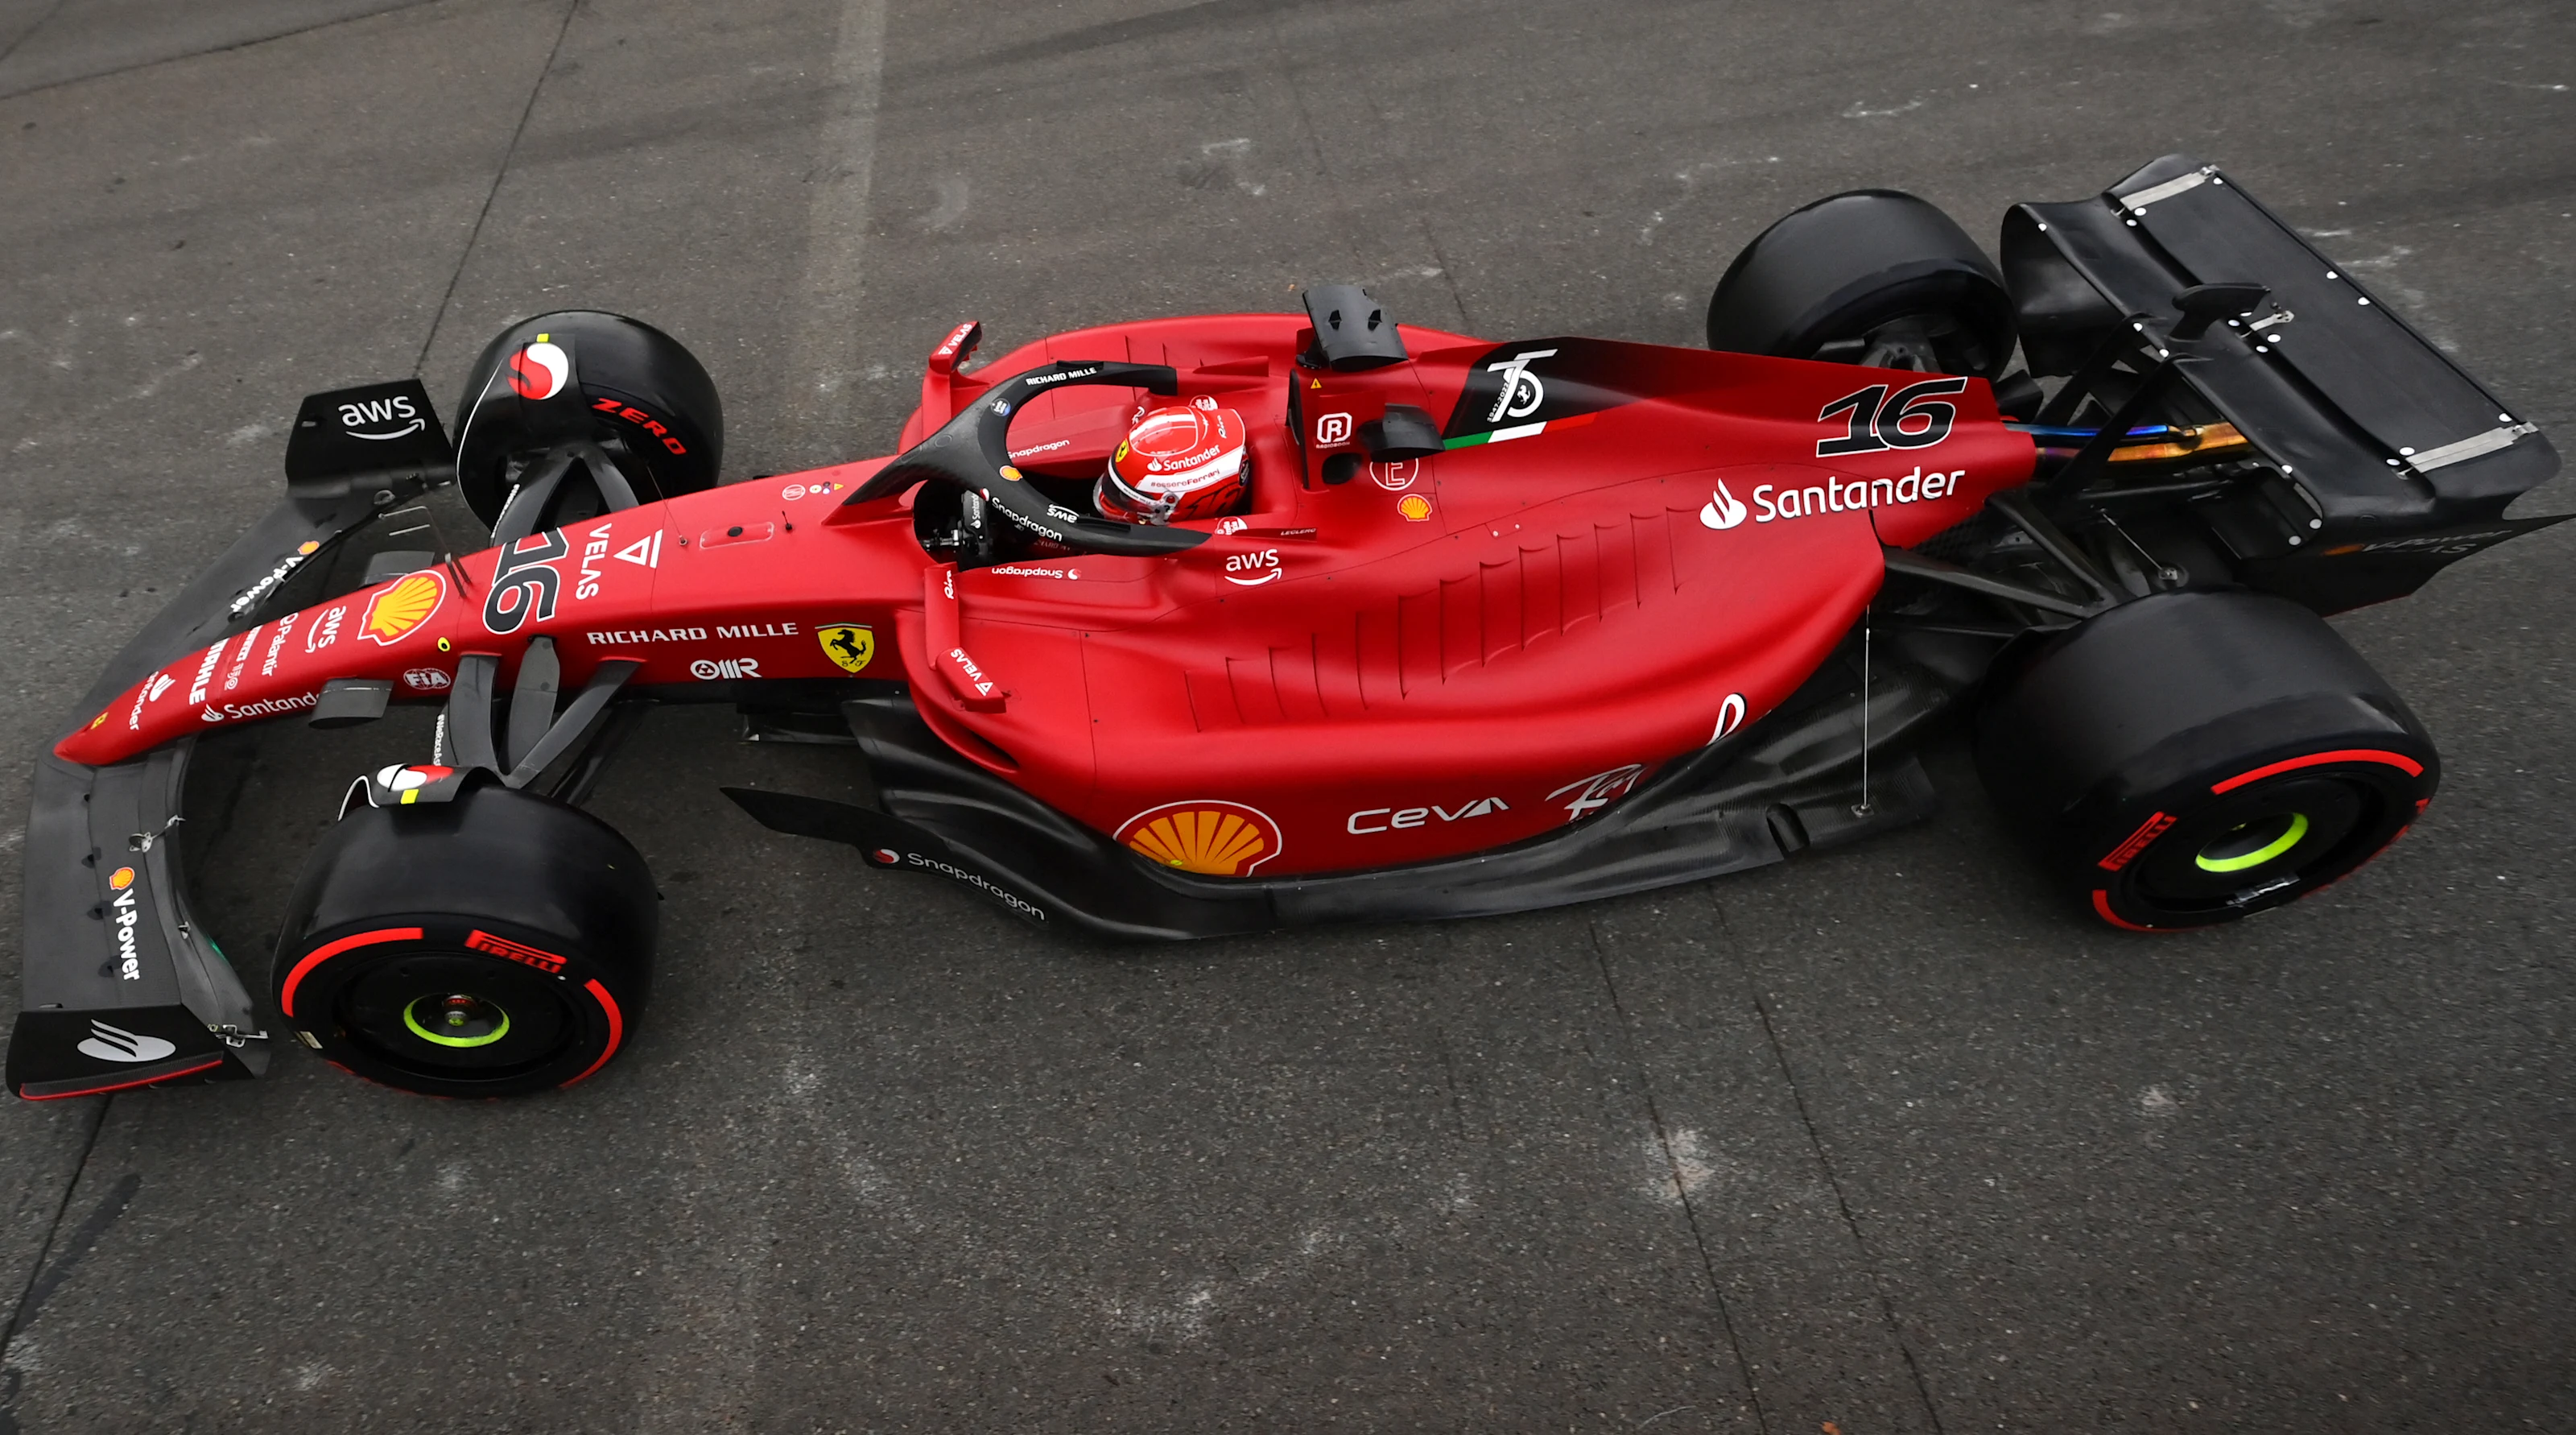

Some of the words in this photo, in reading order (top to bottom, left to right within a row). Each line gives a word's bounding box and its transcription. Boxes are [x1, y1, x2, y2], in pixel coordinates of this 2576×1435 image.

[948, 324, 972, 346] VELAS
[1026, 372, 1067, 386] RICHARD
[1067, 367, 1097, 379] MILLE
[338, 395, 415, 427] aws
[592, 397, 687, 455] ZERO
[1816, 376, 1967, 458] 16
[1163, 445, 1220, 471] Santander
[1046, 508, 1078, 523] aws
[1753, 466, 1965, 524] Santander
[991, 496, 1063, 542] Snapdragon
[482, 527, 570, 635] 16
[576, 523, 613, 600] VELAS
[991, 566, 1063, 579] Snapdragon
[1225, 548, 1280, 572] aws
[230, 556, 304, 613] V-Power
[262, 624, 293, 676] Palantir
[317, 606, 347, 648] aws
[586, 627, 708, 645] RICHARD
[716, 622, 799, 639] MILLE
[950, 648, 982, 682] VELAS
[2096, 810, 2178, 873] PIRELLI
[907, 852, 1046, 920] Snapdragon
[113, 888, 140, 981] V-Power
[464, 928, 568, 974] PIRELLI
